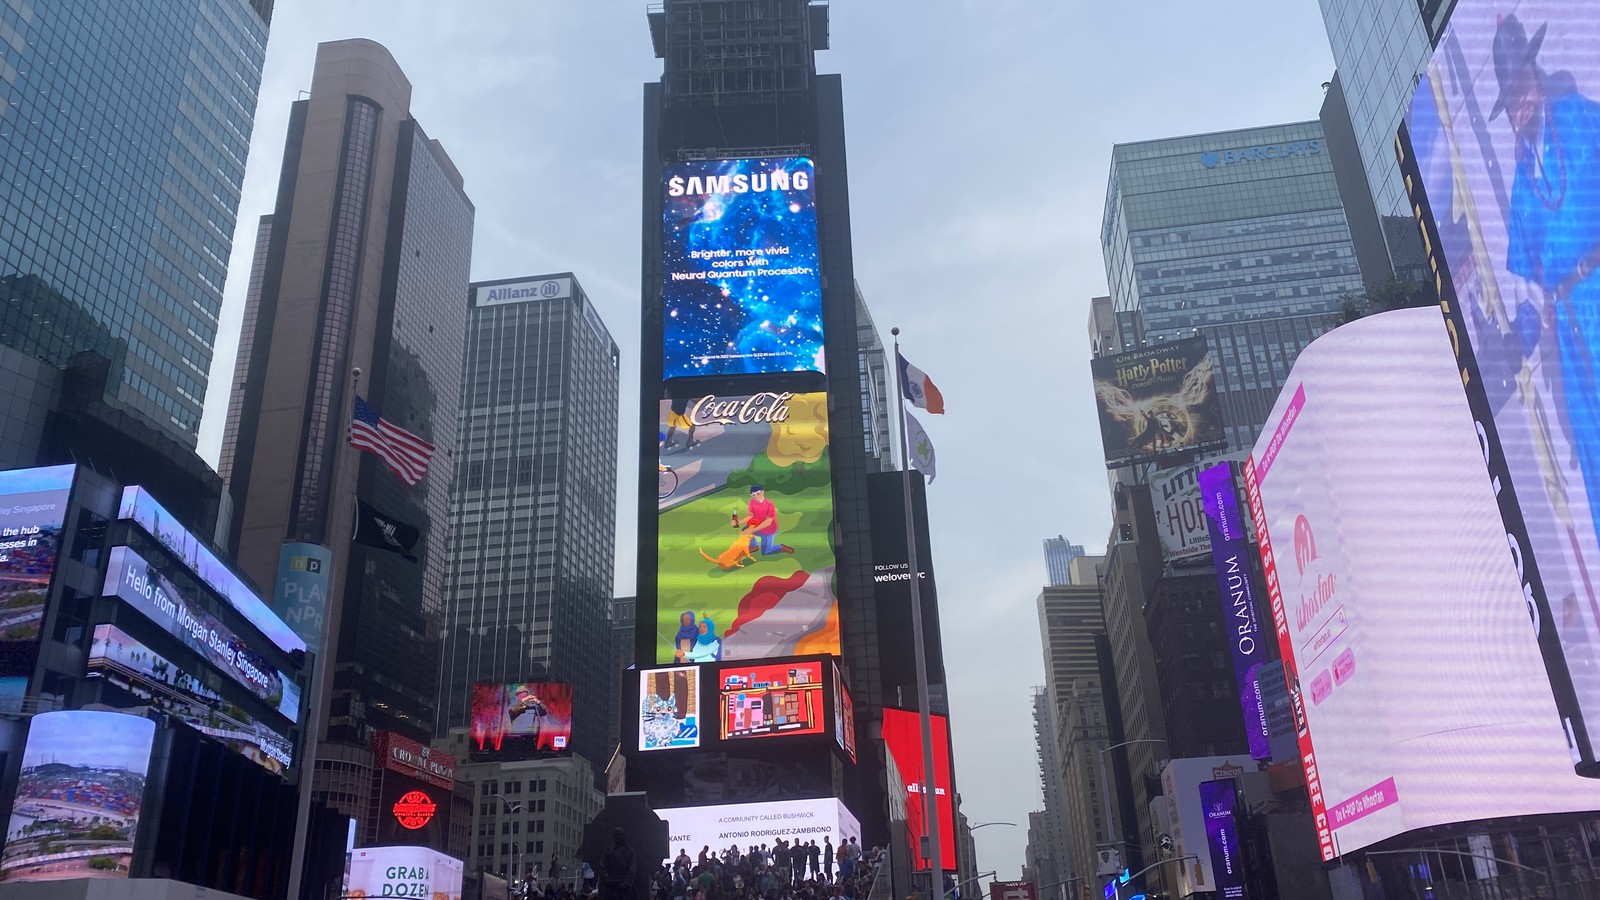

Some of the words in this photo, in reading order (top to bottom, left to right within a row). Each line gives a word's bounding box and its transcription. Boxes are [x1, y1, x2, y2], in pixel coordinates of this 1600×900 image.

[1225, 141, 1320, 164] BARCLAYS
[668, 172, 809, 196] SAMSUNG
[691, 249, 734, 260] Brighter,
[765, 246, 789, 255] vivid
[712, 260, 744, 268] colors
[745, 258, 769, 266] with
[672, 271, 706, 281] Neural
[707, 269, 756, 279] Quantum
[487, 287, 538, 301] Allianz
[1134, 345, 1180, 360] BROADWAY
[1116, 364, 1150, 386] Harry
[1150, 357, 1187, 380] Potter
[690, 392, 794, 426] Coca-Cola
[13, 504, 56, 514] Singapore
[1216, 492, 1230, 541] oranum.com
[3, 527, 19, 536] the
[20, 525, 40, 534] hub
[28, 537, 38, 546] in
[1169, 545, 1198, 557] Westside
[1245, 460, 1272, 568] HERSHEY'S
[1267, 569, 1288, 640] STORE
[1225, 554, 1255, 655] ORANUM
[126, 565, 152, 599] Hello
[153, 587, 176, 619] from
[177, 604, 208, 643] Morgan
[209, 630, 236, 666] Stanley
[235, 651, 268, 688] Singapore
[1253, 680, 1268, 736] oranum.com
[1304, 752, 1322, 807] FREE
[750, 826, 832, 837] RODRIGUEZ-ZAMBRONO
[1220, 828, 1232, 874] oranum.com
[386, 866, 424, 880] GRAB
[382, 883, 429, 898] DOZEN
